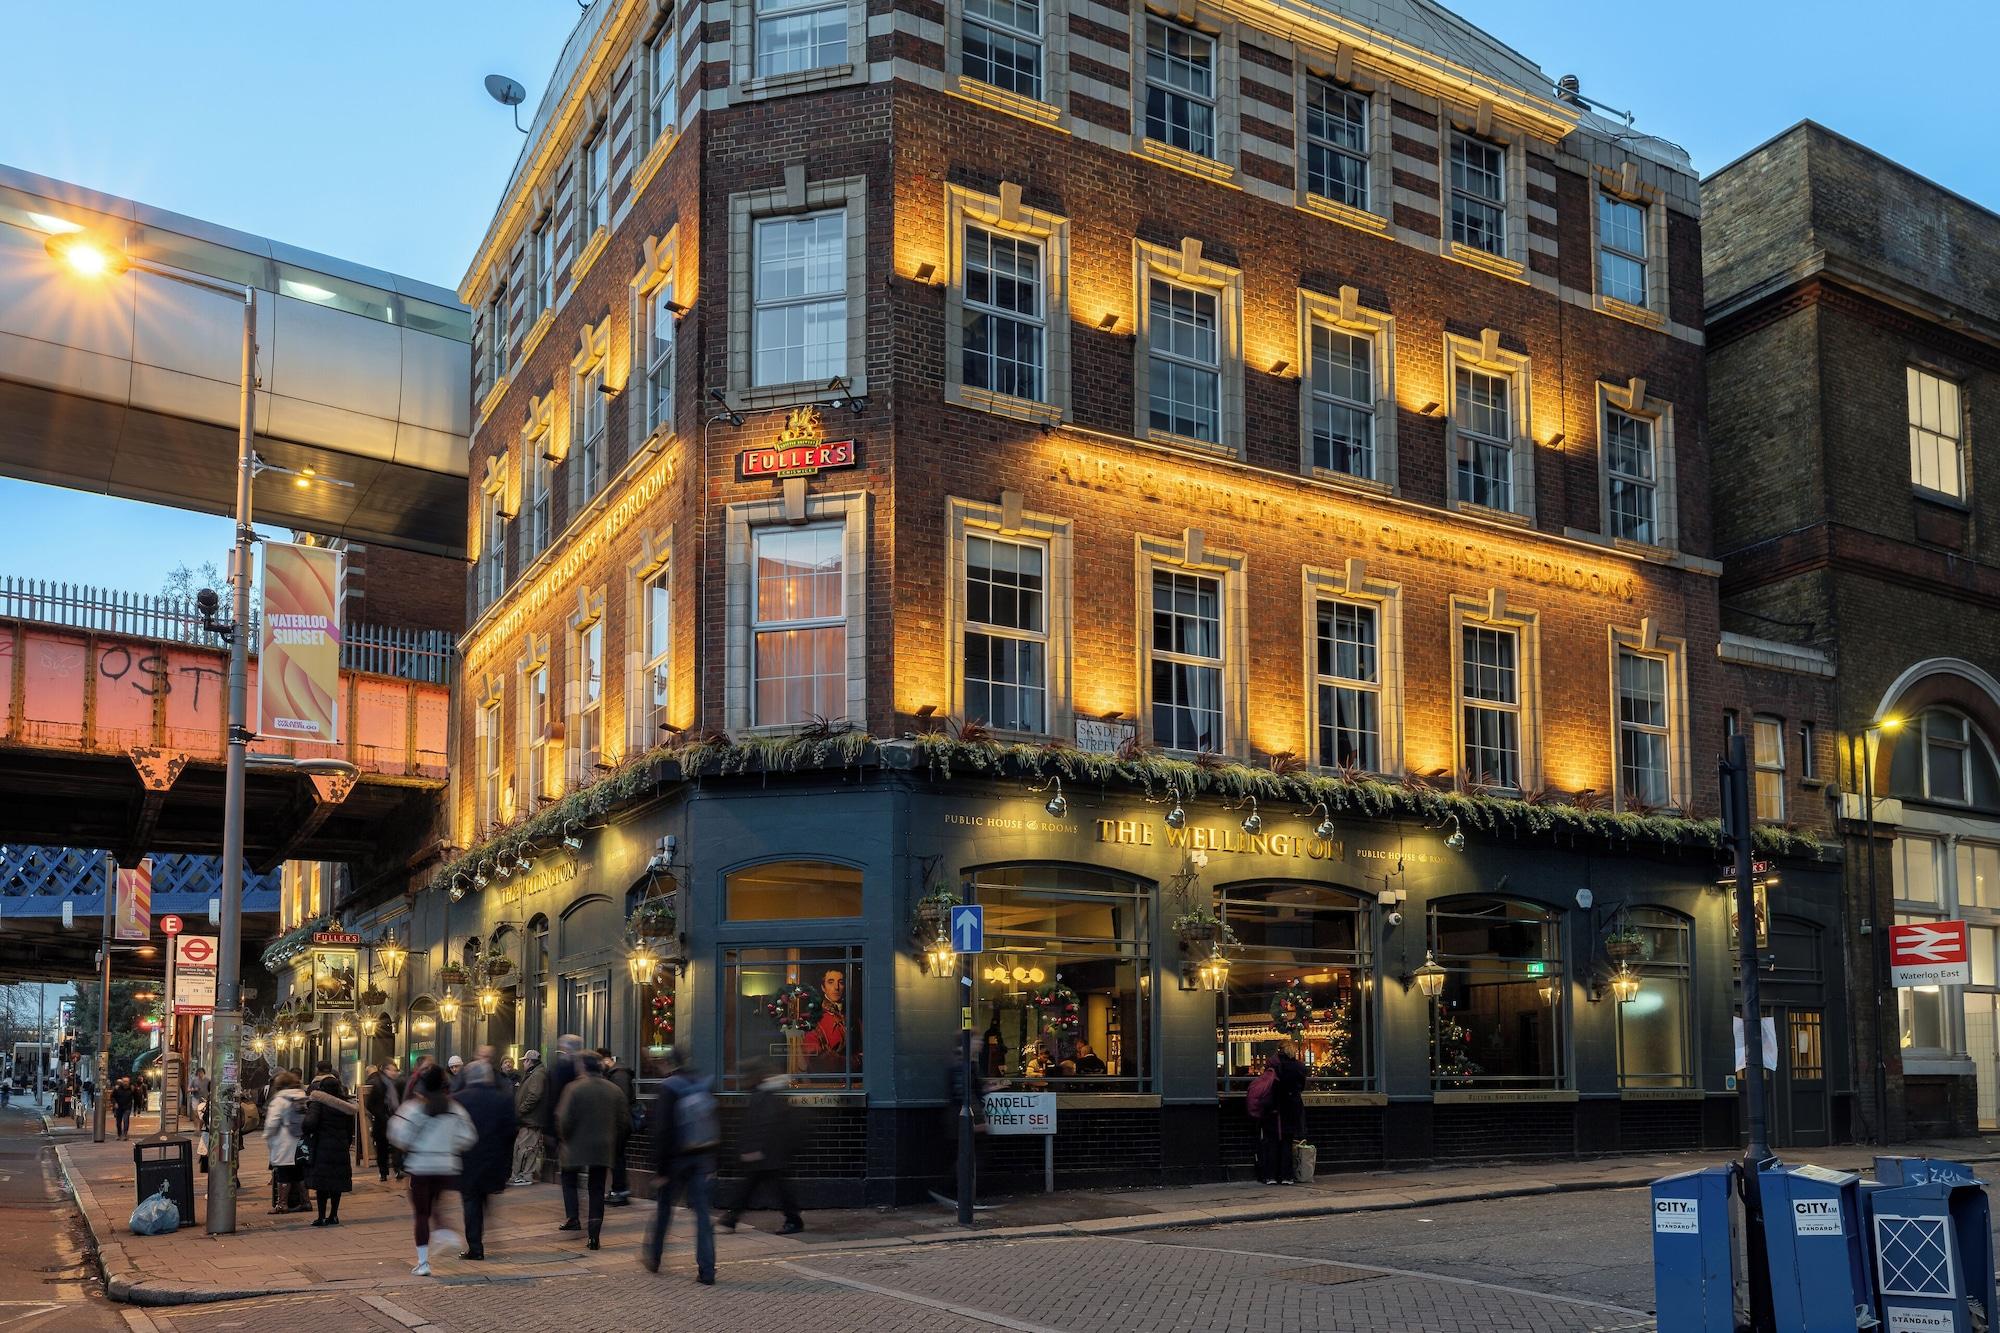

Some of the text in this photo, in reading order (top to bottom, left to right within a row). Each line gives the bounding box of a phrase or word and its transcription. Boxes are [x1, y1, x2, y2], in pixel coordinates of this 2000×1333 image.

[748, 445, 847, 471] FULLER'S
[1055, 452, 1125, 490] ALES
[1139, 470, 1161, 498] &
[1175, 478, 1283, 523] SPIRITS
[1315, 510, 1366, 540] PUB
[1375, 523, 1488, 571] CLASSICS
[1510, 552, 1634, 602] BEDROOMS
[492, 606, 524, 645] SPIRITS
[531, 581, 549, 614] PUB
[551, 531, 598, 592] CLASSICS
[605, 455, 674, 541] BEDROOMS
[267, 613, 328, 628] WATERLOO
[272, 628, 326, 645] SUNSET
[945, 814, 983, 826] PUBLIC
[987, 818, 1023, 829] HOUSE
[1041, 822, 1079, 834] ROOMS
[1096, 818, 1345, 863] THE WELLINGTON
[1357, 849, 1386, 859] PUBLIC
[1388, 851, 1416, 862] HOUSE
[166, 917, 178, 931] E
[1900, 970, 1960, 980] Waterloo East
[986, 1114, 1049, 1125] TREET SE1
[1657, 1202, 1687, 1212] CITY
[1796, 1203, 1828, 1213] CITY
[1892, 1316, 1941, 1326] STANDARD
